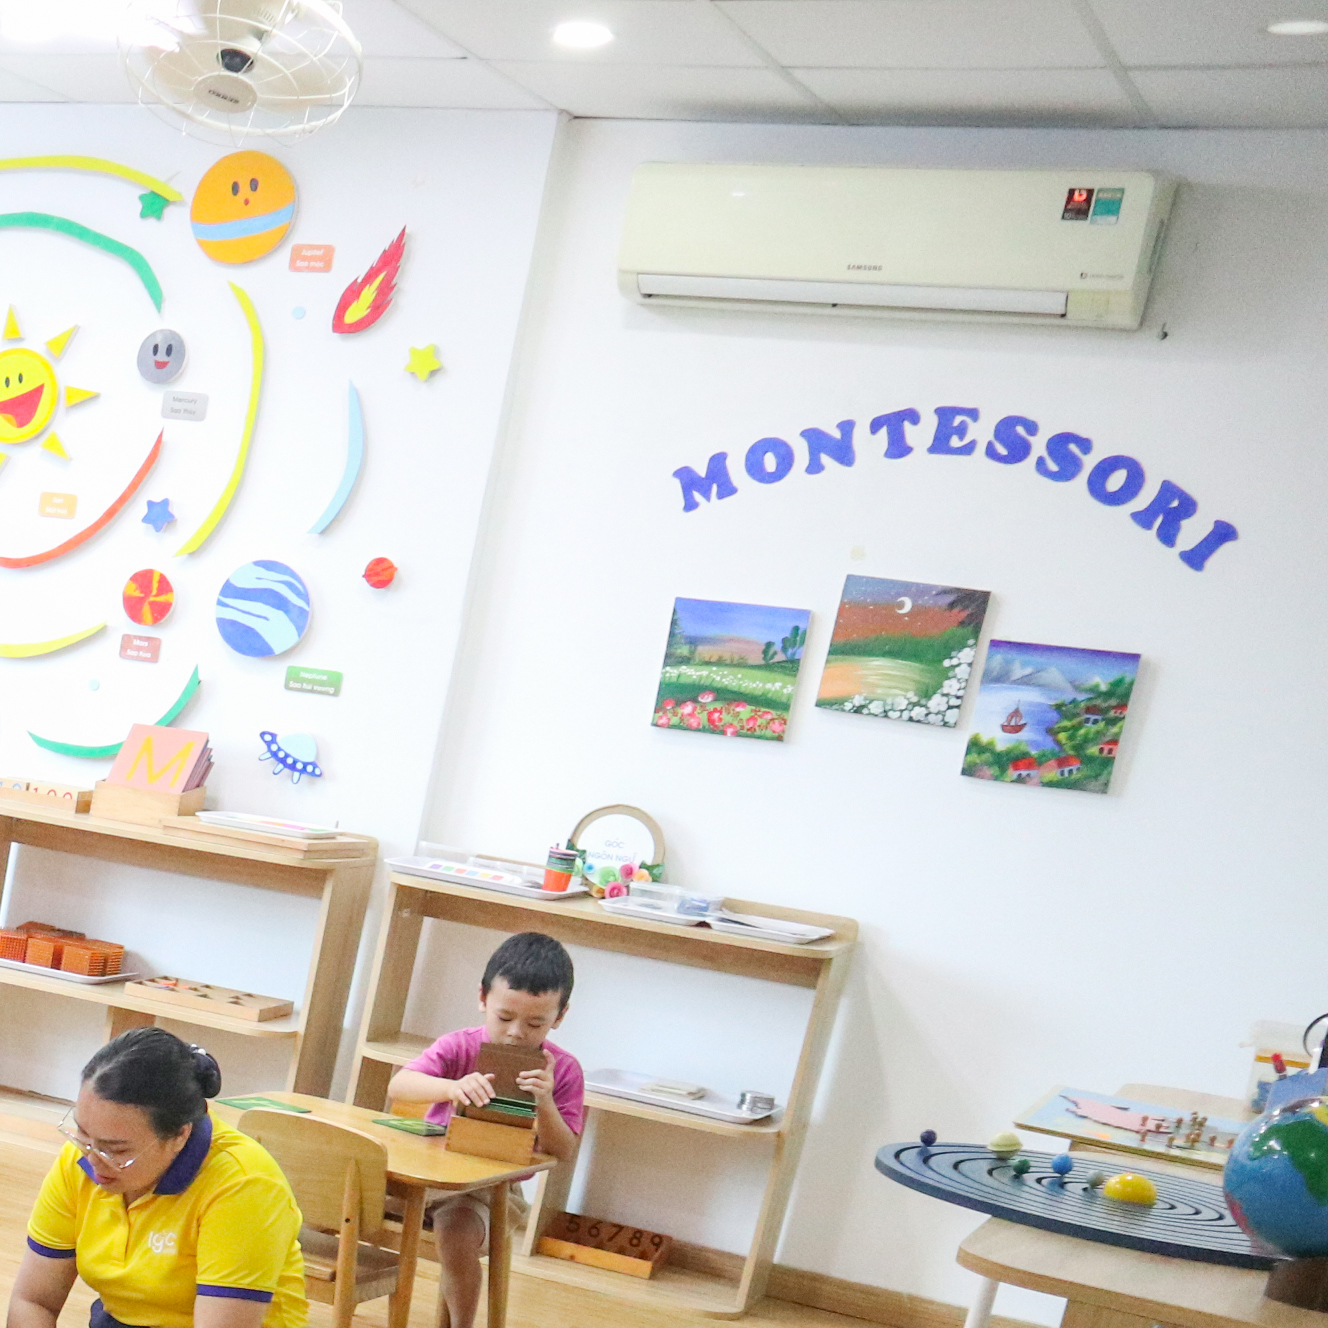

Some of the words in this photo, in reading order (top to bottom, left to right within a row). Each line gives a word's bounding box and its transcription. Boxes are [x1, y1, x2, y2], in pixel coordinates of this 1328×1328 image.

[172, 396, 199, 405] Mercury
[672, 405, 1239, 572] MONTESSORI
[629, 1230, 643, 1247] 8
[650, 1234, 663, 1252] 9
